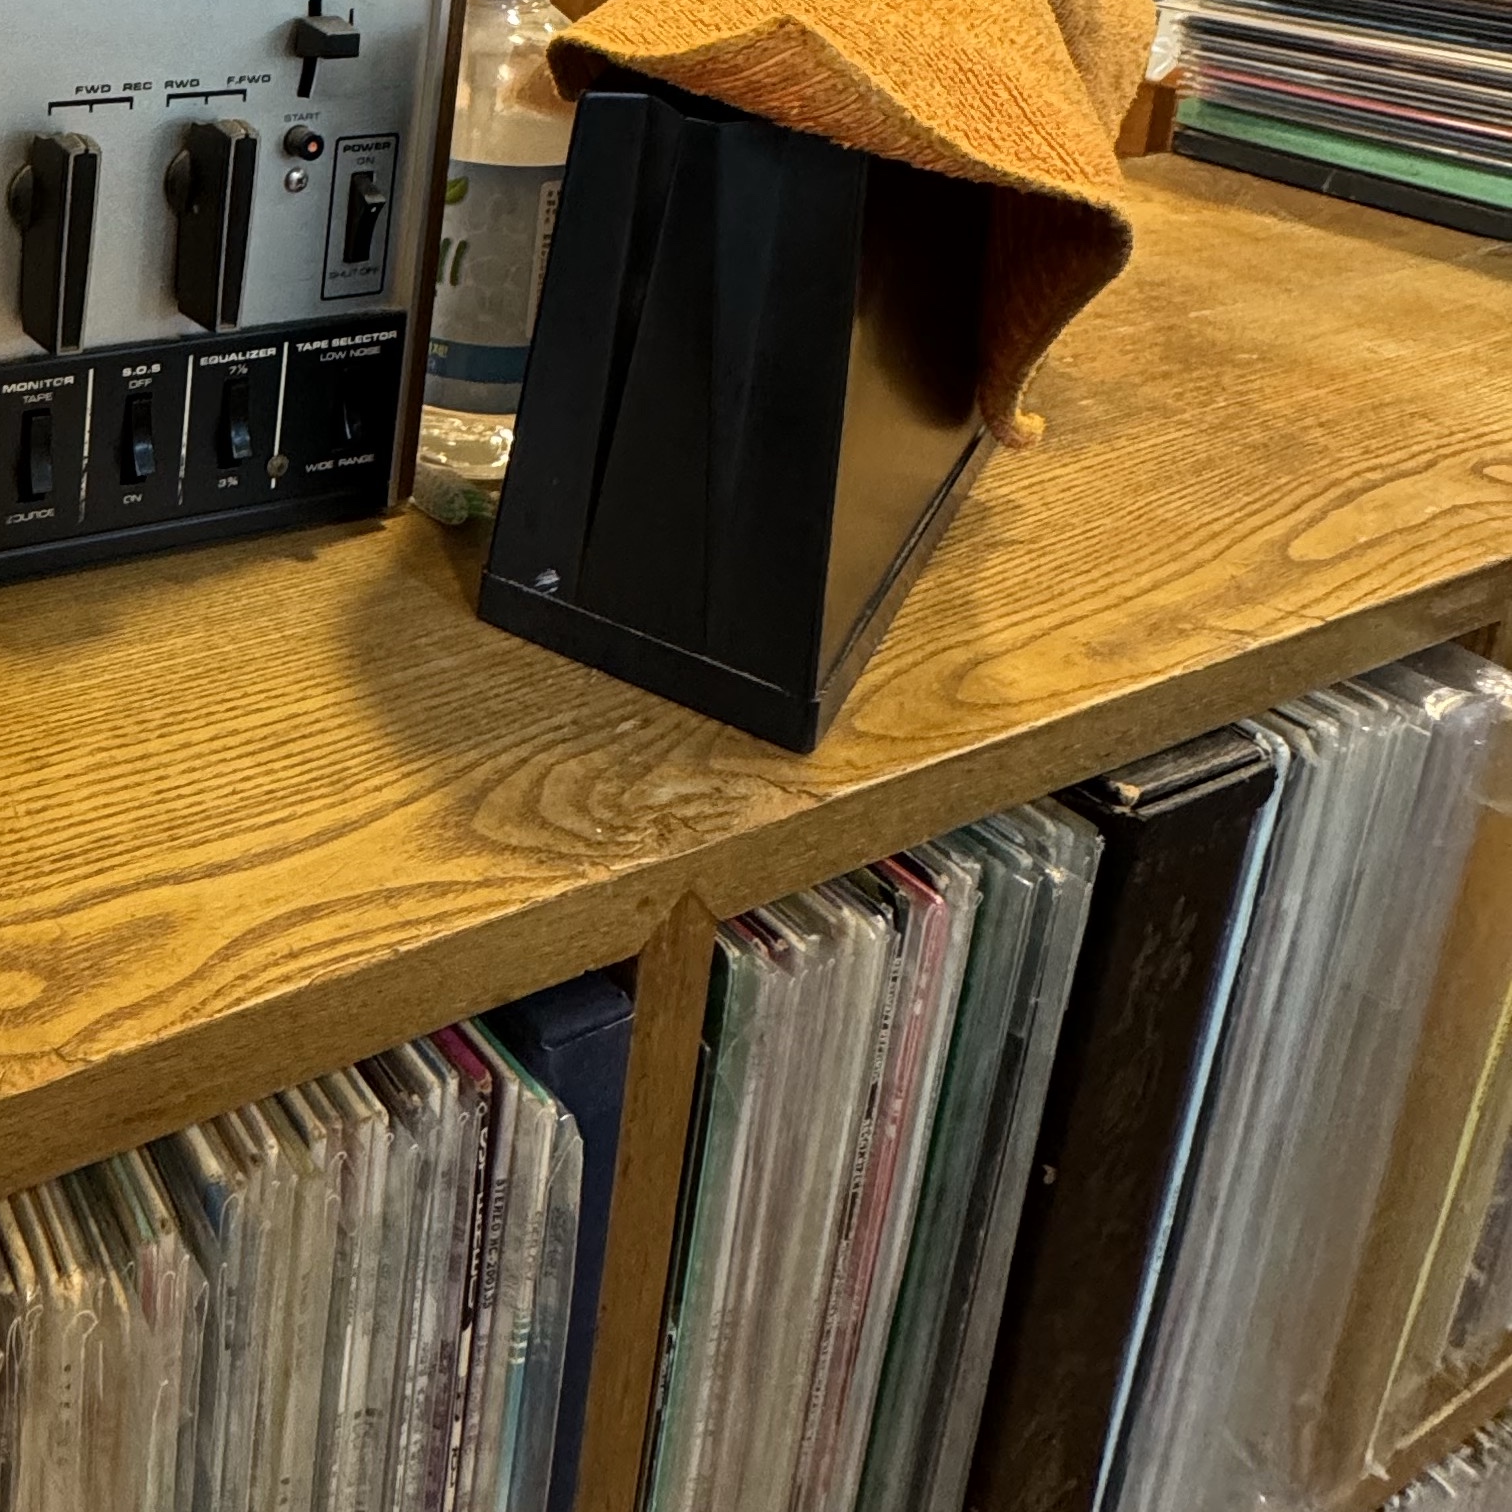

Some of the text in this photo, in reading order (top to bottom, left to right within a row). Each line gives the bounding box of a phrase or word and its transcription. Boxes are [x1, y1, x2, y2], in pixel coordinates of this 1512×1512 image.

[74, 80, 153, 95] FWD REC
[164, 78, 200, 90] RWD
[283, 111, 320, 123] START
[342, 141, 392, 154] POWER
[355, 155, 375, 166] ON
[295, 330, 398, 353] TAPE SELECTOR
[199, 347, 277, 367] EQUALIZER
[319, 345, 381, 363] LOW NOISE
[2, 375, 75, 394] MONITOR
[128, 377, 153, 390] OFF
[23, 391, 54, 405] TAPE
[305, 453, 375, 473] WIDE RANGE
[122, 493, 144, 505] ON
[491, 1178, 508, 1233] STEREO
